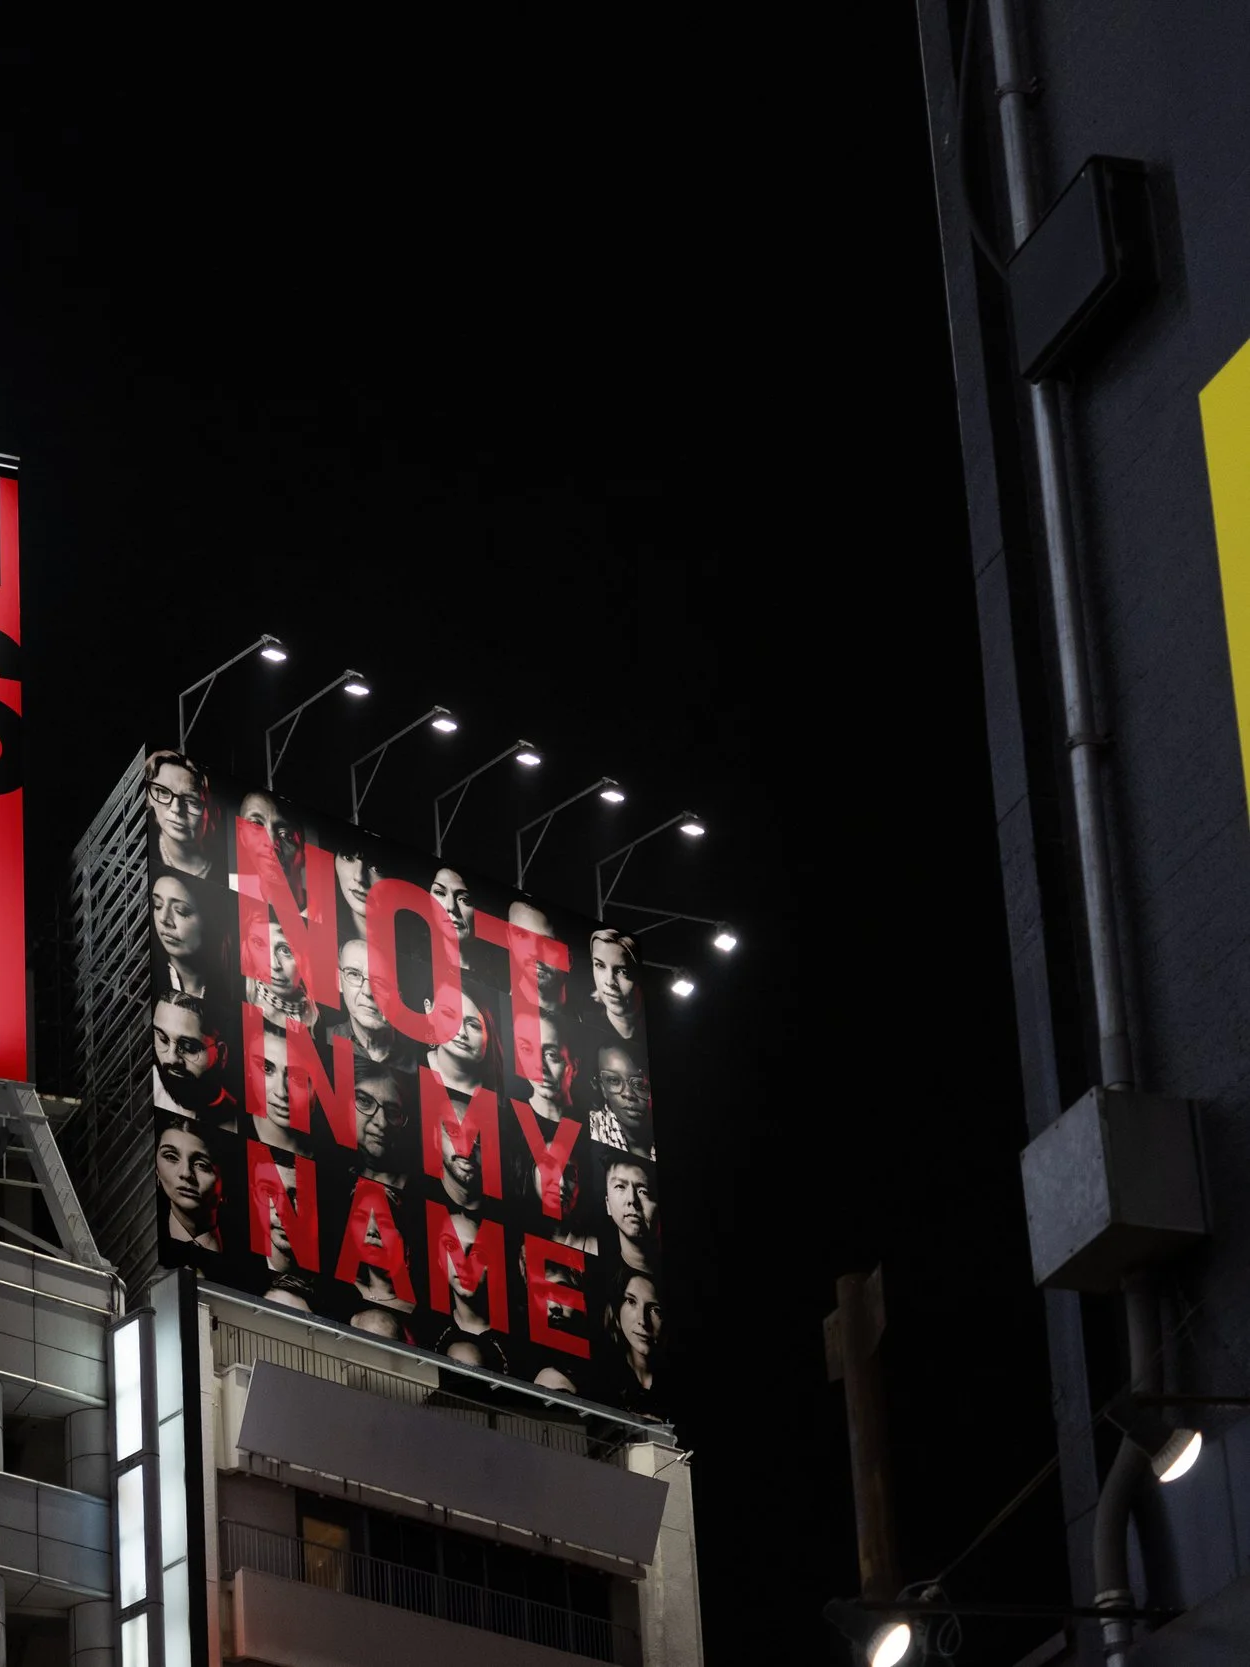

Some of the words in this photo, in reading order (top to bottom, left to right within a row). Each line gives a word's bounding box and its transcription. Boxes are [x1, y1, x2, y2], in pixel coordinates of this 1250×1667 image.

[235, 815, 571, 1081] NOT
[243, 1001, 358, 1150] IN
[419, 1064, 582, 1221] MY
[247, 1138, 591, 1360] NAME
